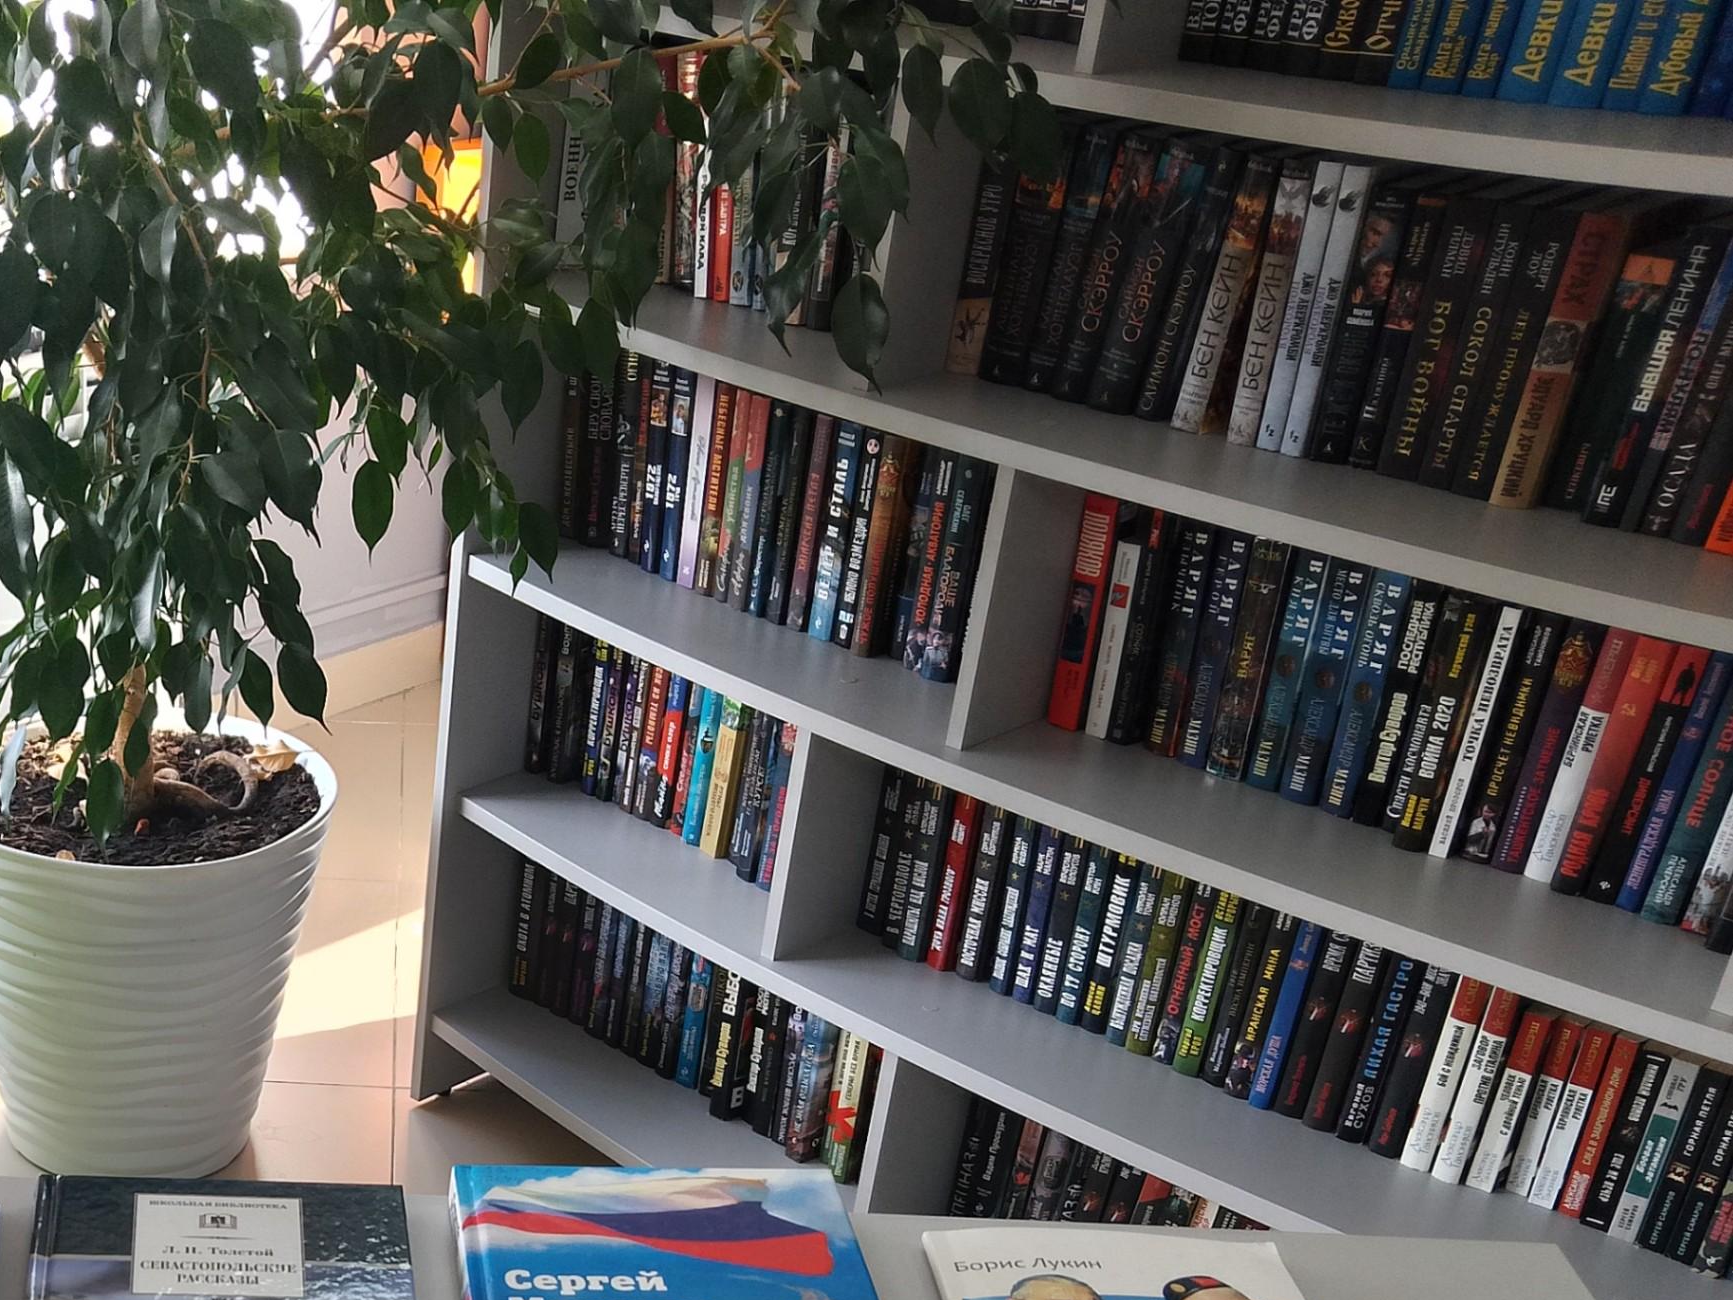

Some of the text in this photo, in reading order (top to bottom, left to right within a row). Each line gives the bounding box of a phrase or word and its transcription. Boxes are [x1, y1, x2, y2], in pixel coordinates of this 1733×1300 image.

[1563, 2, 1616, 89] Девки
[1648, 11, 1705, 98] Дубовый
[966, 184, 1004, 284] ВОСКРЕСНОЕ УТРО
[1081, 231, 1123, 332] СКЭРРОУ
[1122, 239, 1167, 343] СКЭРРОУ
[1191, 253, 1242, 379] БЕН КЕЙН
[1298, 272, 1315, 303] ДЖО
[1242, 261, 1285, 391] БЕН КЕЙН
[1395, 299, 1452, 457] БОГ ВОЙНЫ
[1432, 306, 1493, 469] СОКОЛ СПАРТЫ
[1467, 308, 1529, 481] ЛЕВ ПРОБУЖДАЕТСЯ
[1631, 329, 1676, 413] БЫВШАЯ
[1656, 441, 1698, 508] ОСАДА
[816, 458, 850, 600] ВЕТЕР И СТАЛЬ
[915, 501, 945, 625] ХОЛОДНАЯ АКВАТОРИЯ
[1074, 511, 1111, 577] ПОЛЯКОВ
[1235, 631, 1258, 680] ВАРЯГ
[1397, 600, 1425, 670] ПОСЛЕДНЯЯ
[1407, 602, 1436, 674] РЕСПУБЛИКА
[1461, 624, 1514, 762] ТОЧКА НЕВОЗВРАТА
[1418, 695, 1457, 779] ВОЙНА 2020
[1386, 775, 1414, 818] Спасти
[960, 878, 990, 966] ВОСТОЧНАЯ МИССИЯ
[1014, 924, 1039, 988] ШАХ И МАТ
[1096, 874, 1131, 968] ШТУРМОВИК
[1186, 903, 1206, 940] МОСТ
[1037, 938, 1064, 998] ОКАЯННЫЕ
[1060, 926, 1091, 1008] ПО ТУ СТОРОНУ
[1190, 926, 1228, 1022] КОРРЕКТИРОВЩИК
[1245, 948, 1281, 1041] ИРАНСКАЯ МИНА
[1363, 1025, 1392, 1079] ЛИХАЯ
[1473, 1040, 1503, 1105] ПРОТИВ СТАЛИНА
[1683, 1086, 1717, 1156] ГОРНАЯ ПЕТЛЯ
[140, 1260, 298, 1274] СЕВАСТОПОЛЬСКИЕ
[162, 1246, 180, 1254] Л.
[207, 1245, 274, 1257] Толстой
[177, 1273, 261, 1285] РАССКАЗЫ
[503, 1268, 668, 1296] Сергей
[952, 1256, 1103, 1273] Борис Лукин
